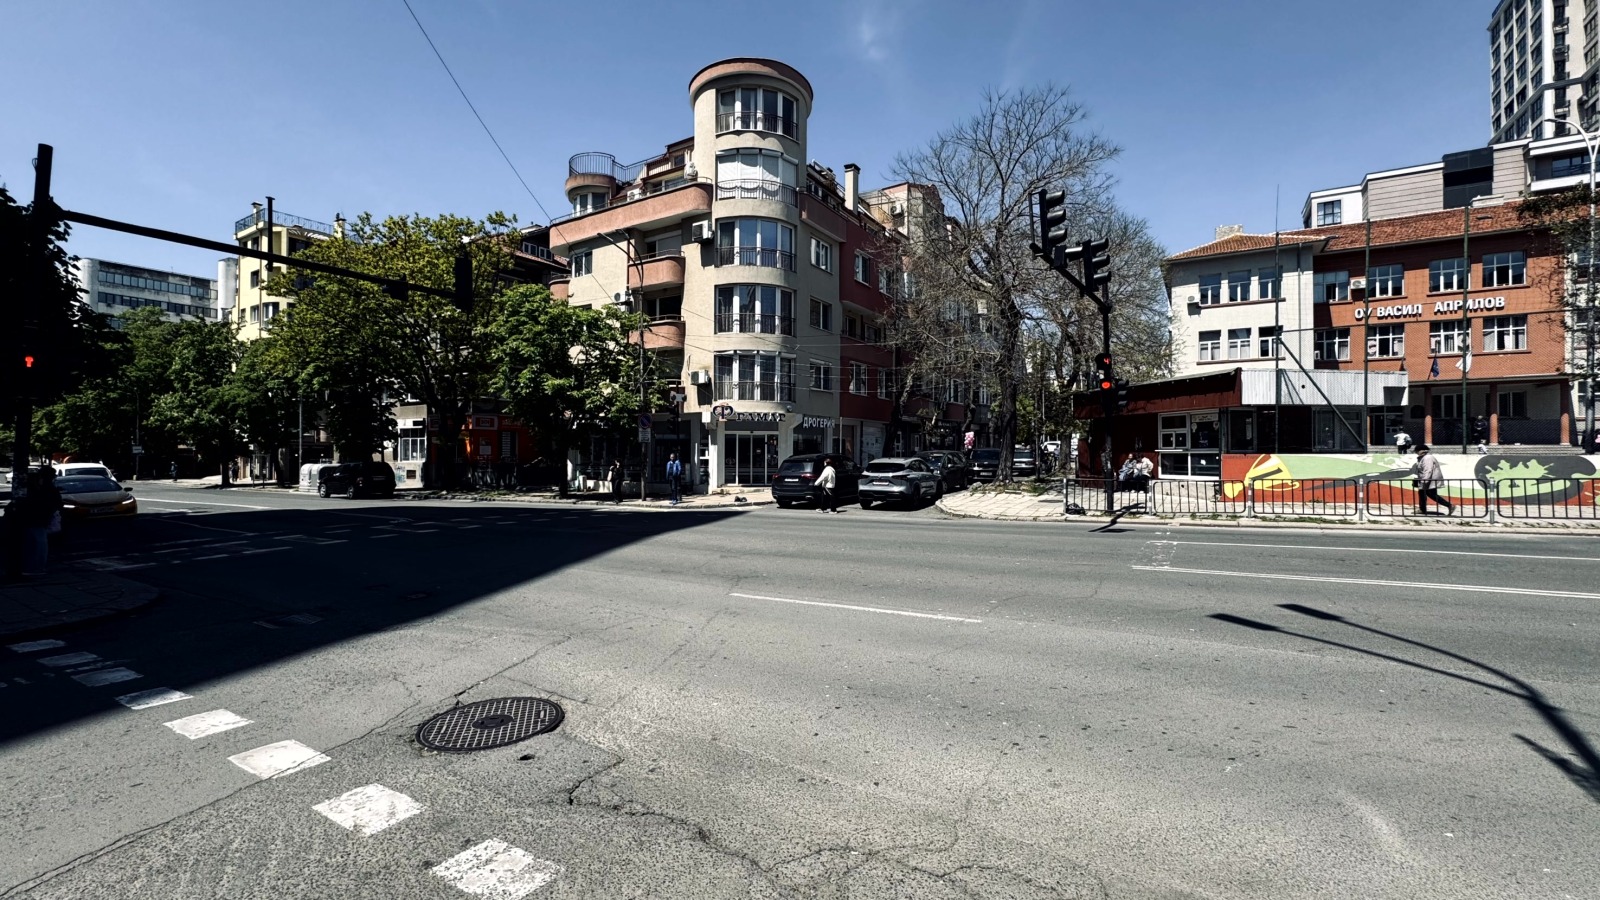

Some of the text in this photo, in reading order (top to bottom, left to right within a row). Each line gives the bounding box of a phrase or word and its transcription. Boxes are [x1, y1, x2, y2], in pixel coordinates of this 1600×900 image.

[1376, 303, 1422, 317] ВАСИЛ
[1434, 296, 1505, 312] АПРИЛОВ
[803, 416, 836, 428] ДРОГЕРИЯ
